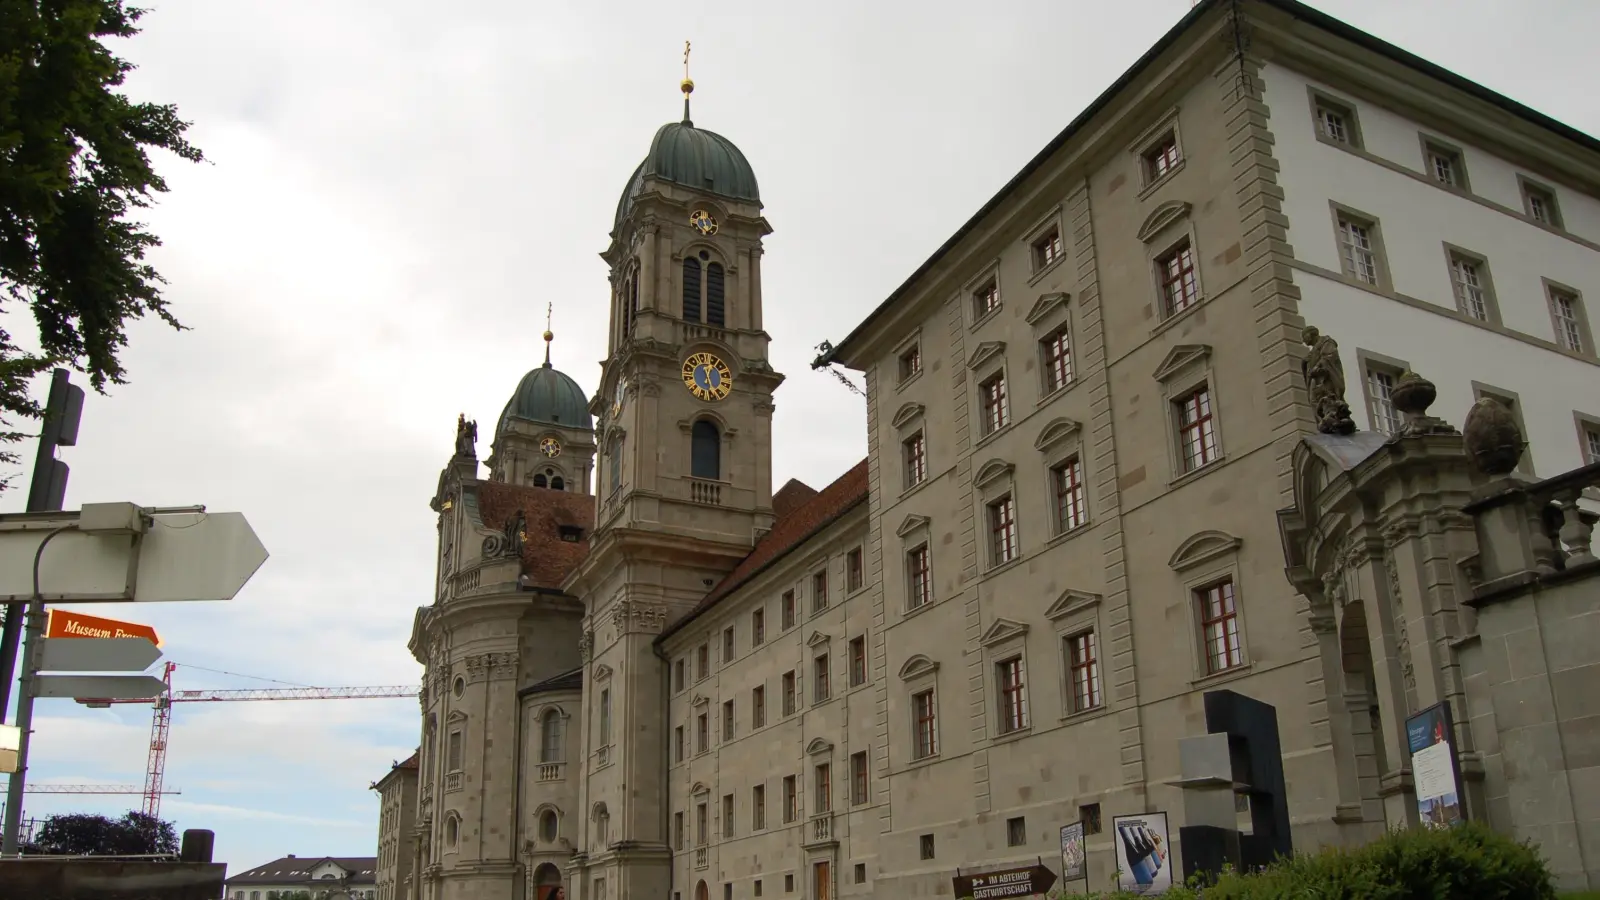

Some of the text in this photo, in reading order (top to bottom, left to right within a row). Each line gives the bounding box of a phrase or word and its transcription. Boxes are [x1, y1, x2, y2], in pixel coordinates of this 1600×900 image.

[64, 620, 111, 638] Museum
[988, 870, 1031, 885] IM ABTEIHOF
[973, 882, 1032, 899] GASTWIRTSCHAFT
